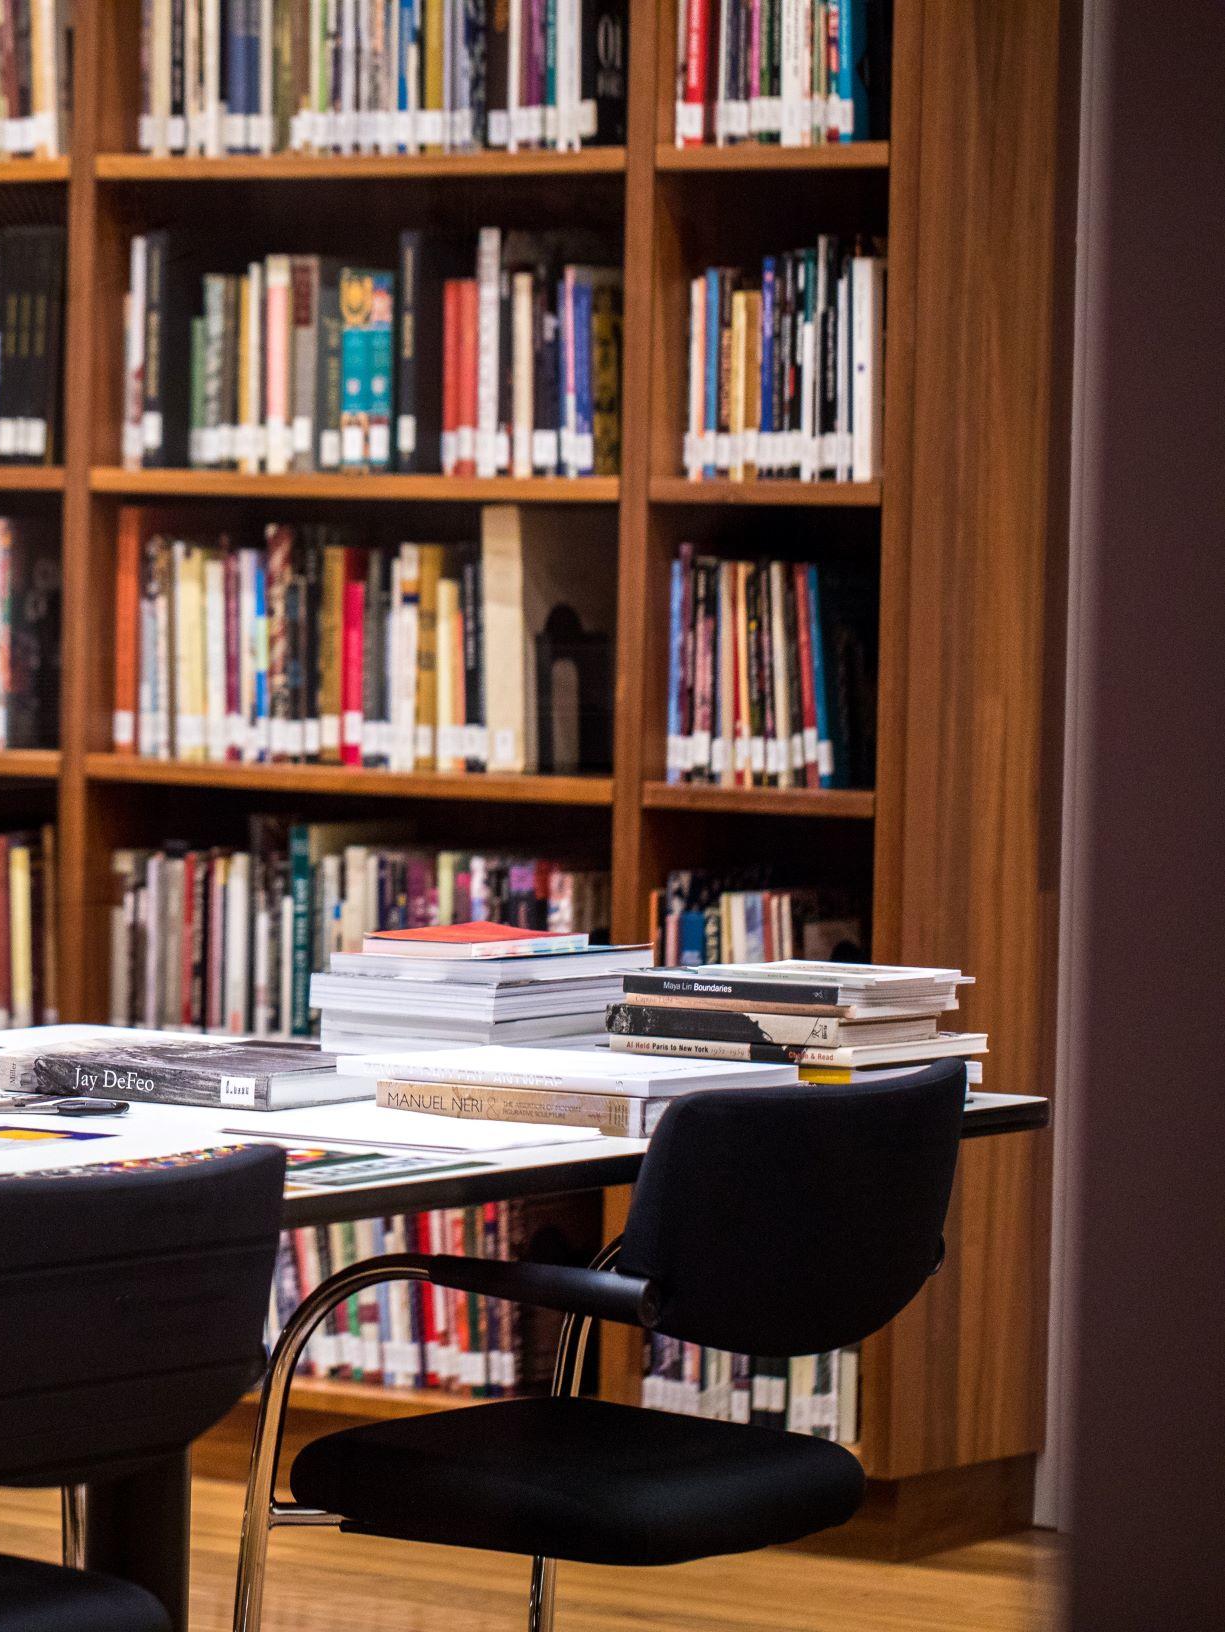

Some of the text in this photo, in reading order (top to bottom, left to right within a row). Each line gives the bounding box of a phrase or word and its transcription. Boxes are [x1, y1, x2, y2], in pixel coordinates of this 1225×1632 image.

[663, 981, 733, 993] Maya Lin Boundaries
[635, 1041, 650, 1050] Held
[651, 1042, 669, 1051] Paris
[678, 1044, 692, 1052] New
[694, 1045, 709, 1053] York
[817, 1053, 834, 1061] Read
[9, 1062, 17, 1085] Miller
[72, 1064, 155, 1093] Jay DeFeo
[387, 1092, 447, 1112] MANUEL
[451, 1096, 483, 1113] NERI
